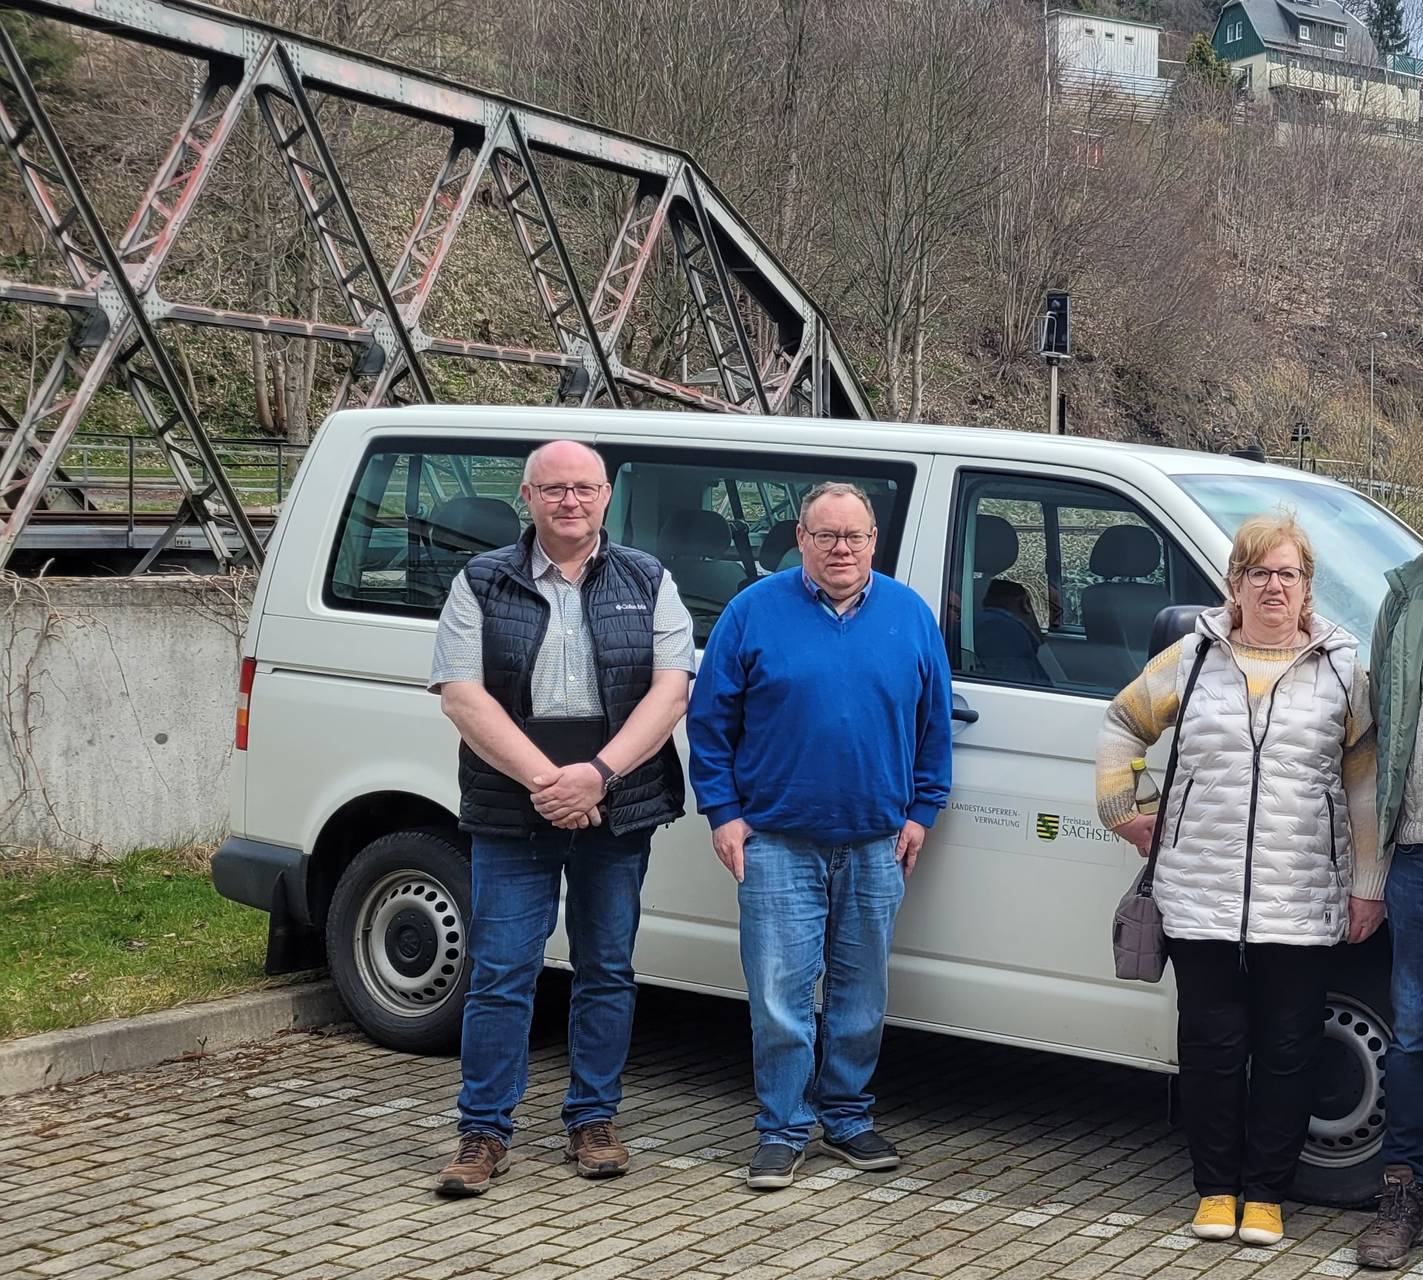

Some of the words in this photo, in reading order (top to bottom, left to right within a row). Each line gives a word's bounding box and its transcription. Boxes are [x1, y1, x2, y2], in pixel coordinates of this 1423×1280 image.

[974, 815, 1020, 828] VERWALTUNG
[1062, 815, 1092, 826] Freistaat
[1061, 824, 1120, 843] SACHSEN
